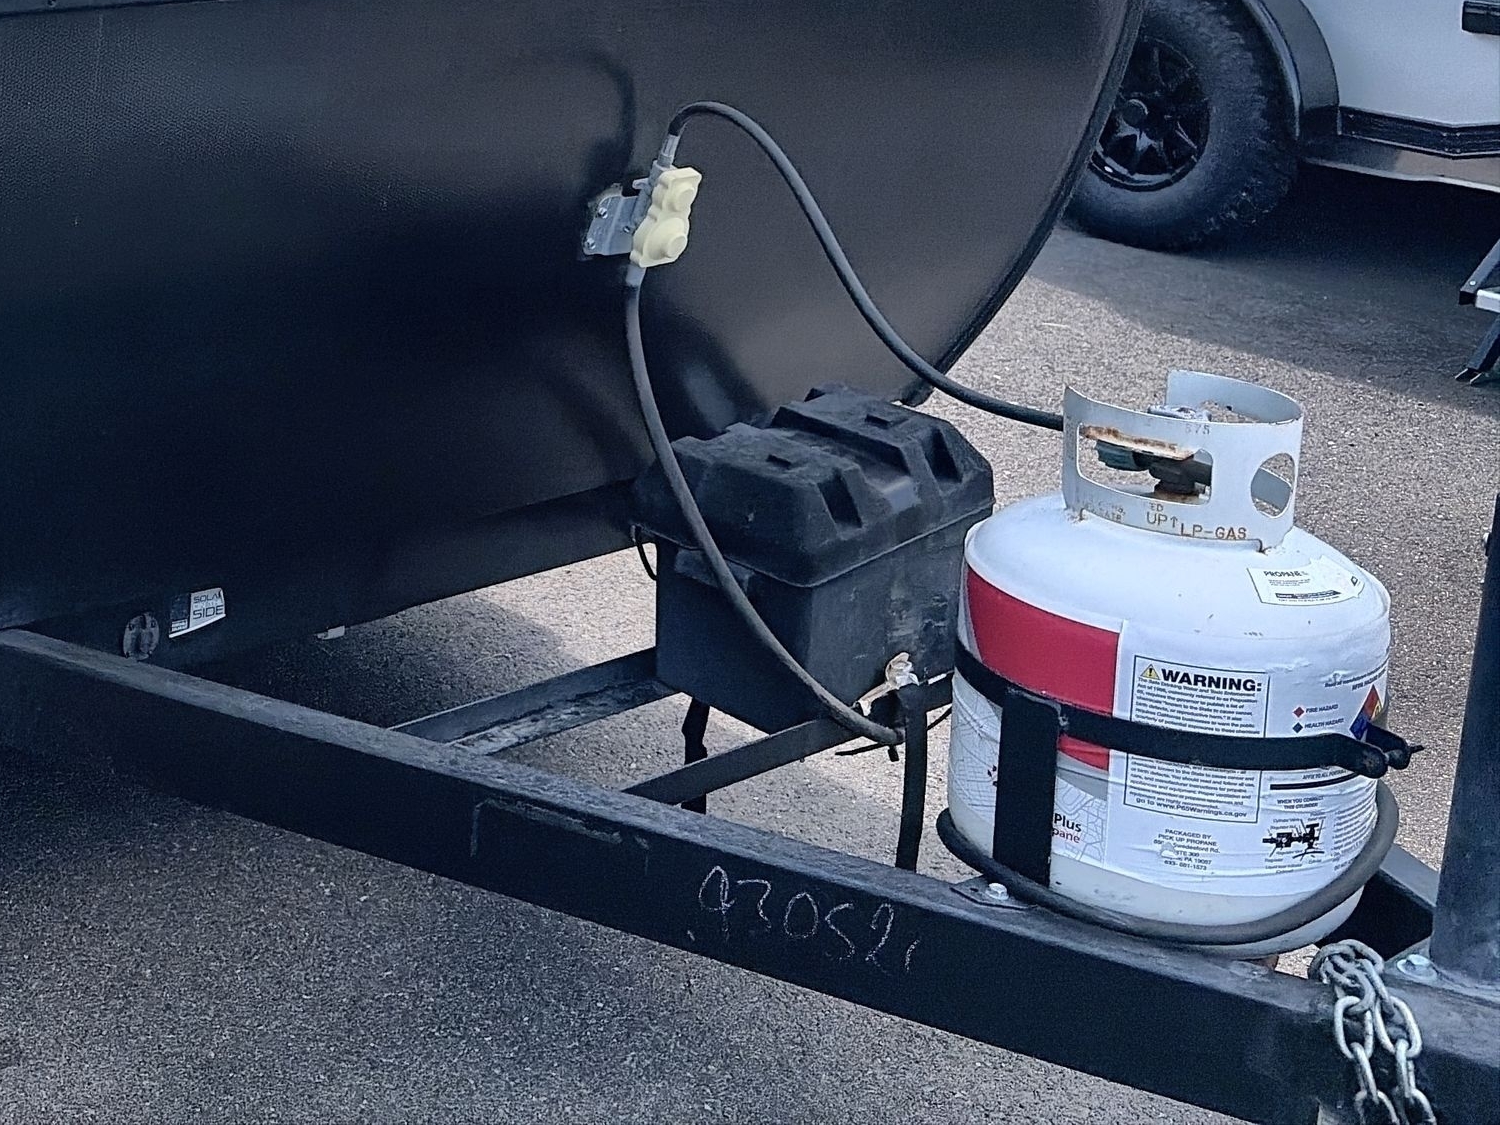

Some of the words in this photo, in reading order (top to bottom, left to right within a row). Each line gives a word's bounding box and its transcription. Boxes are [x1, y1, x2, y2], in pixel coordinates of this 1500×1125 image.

[1146, 511, 1168, 525] UP
[1180, 523, 1248, 540] LP-GAS
[193, 605, 224, 620] SIDE
[1161, 668, 1263, 692] WARNING:
[1156, 802, 1247, 817] www.P65Warnings.ca.gov
[1054, 813, 1082, 832] Plus
[1158, 834, 1174, 842] PICK
[1186, 838, 1217, 846] PROPANE
[1165, 828, 1201, 839] PACKAGED
